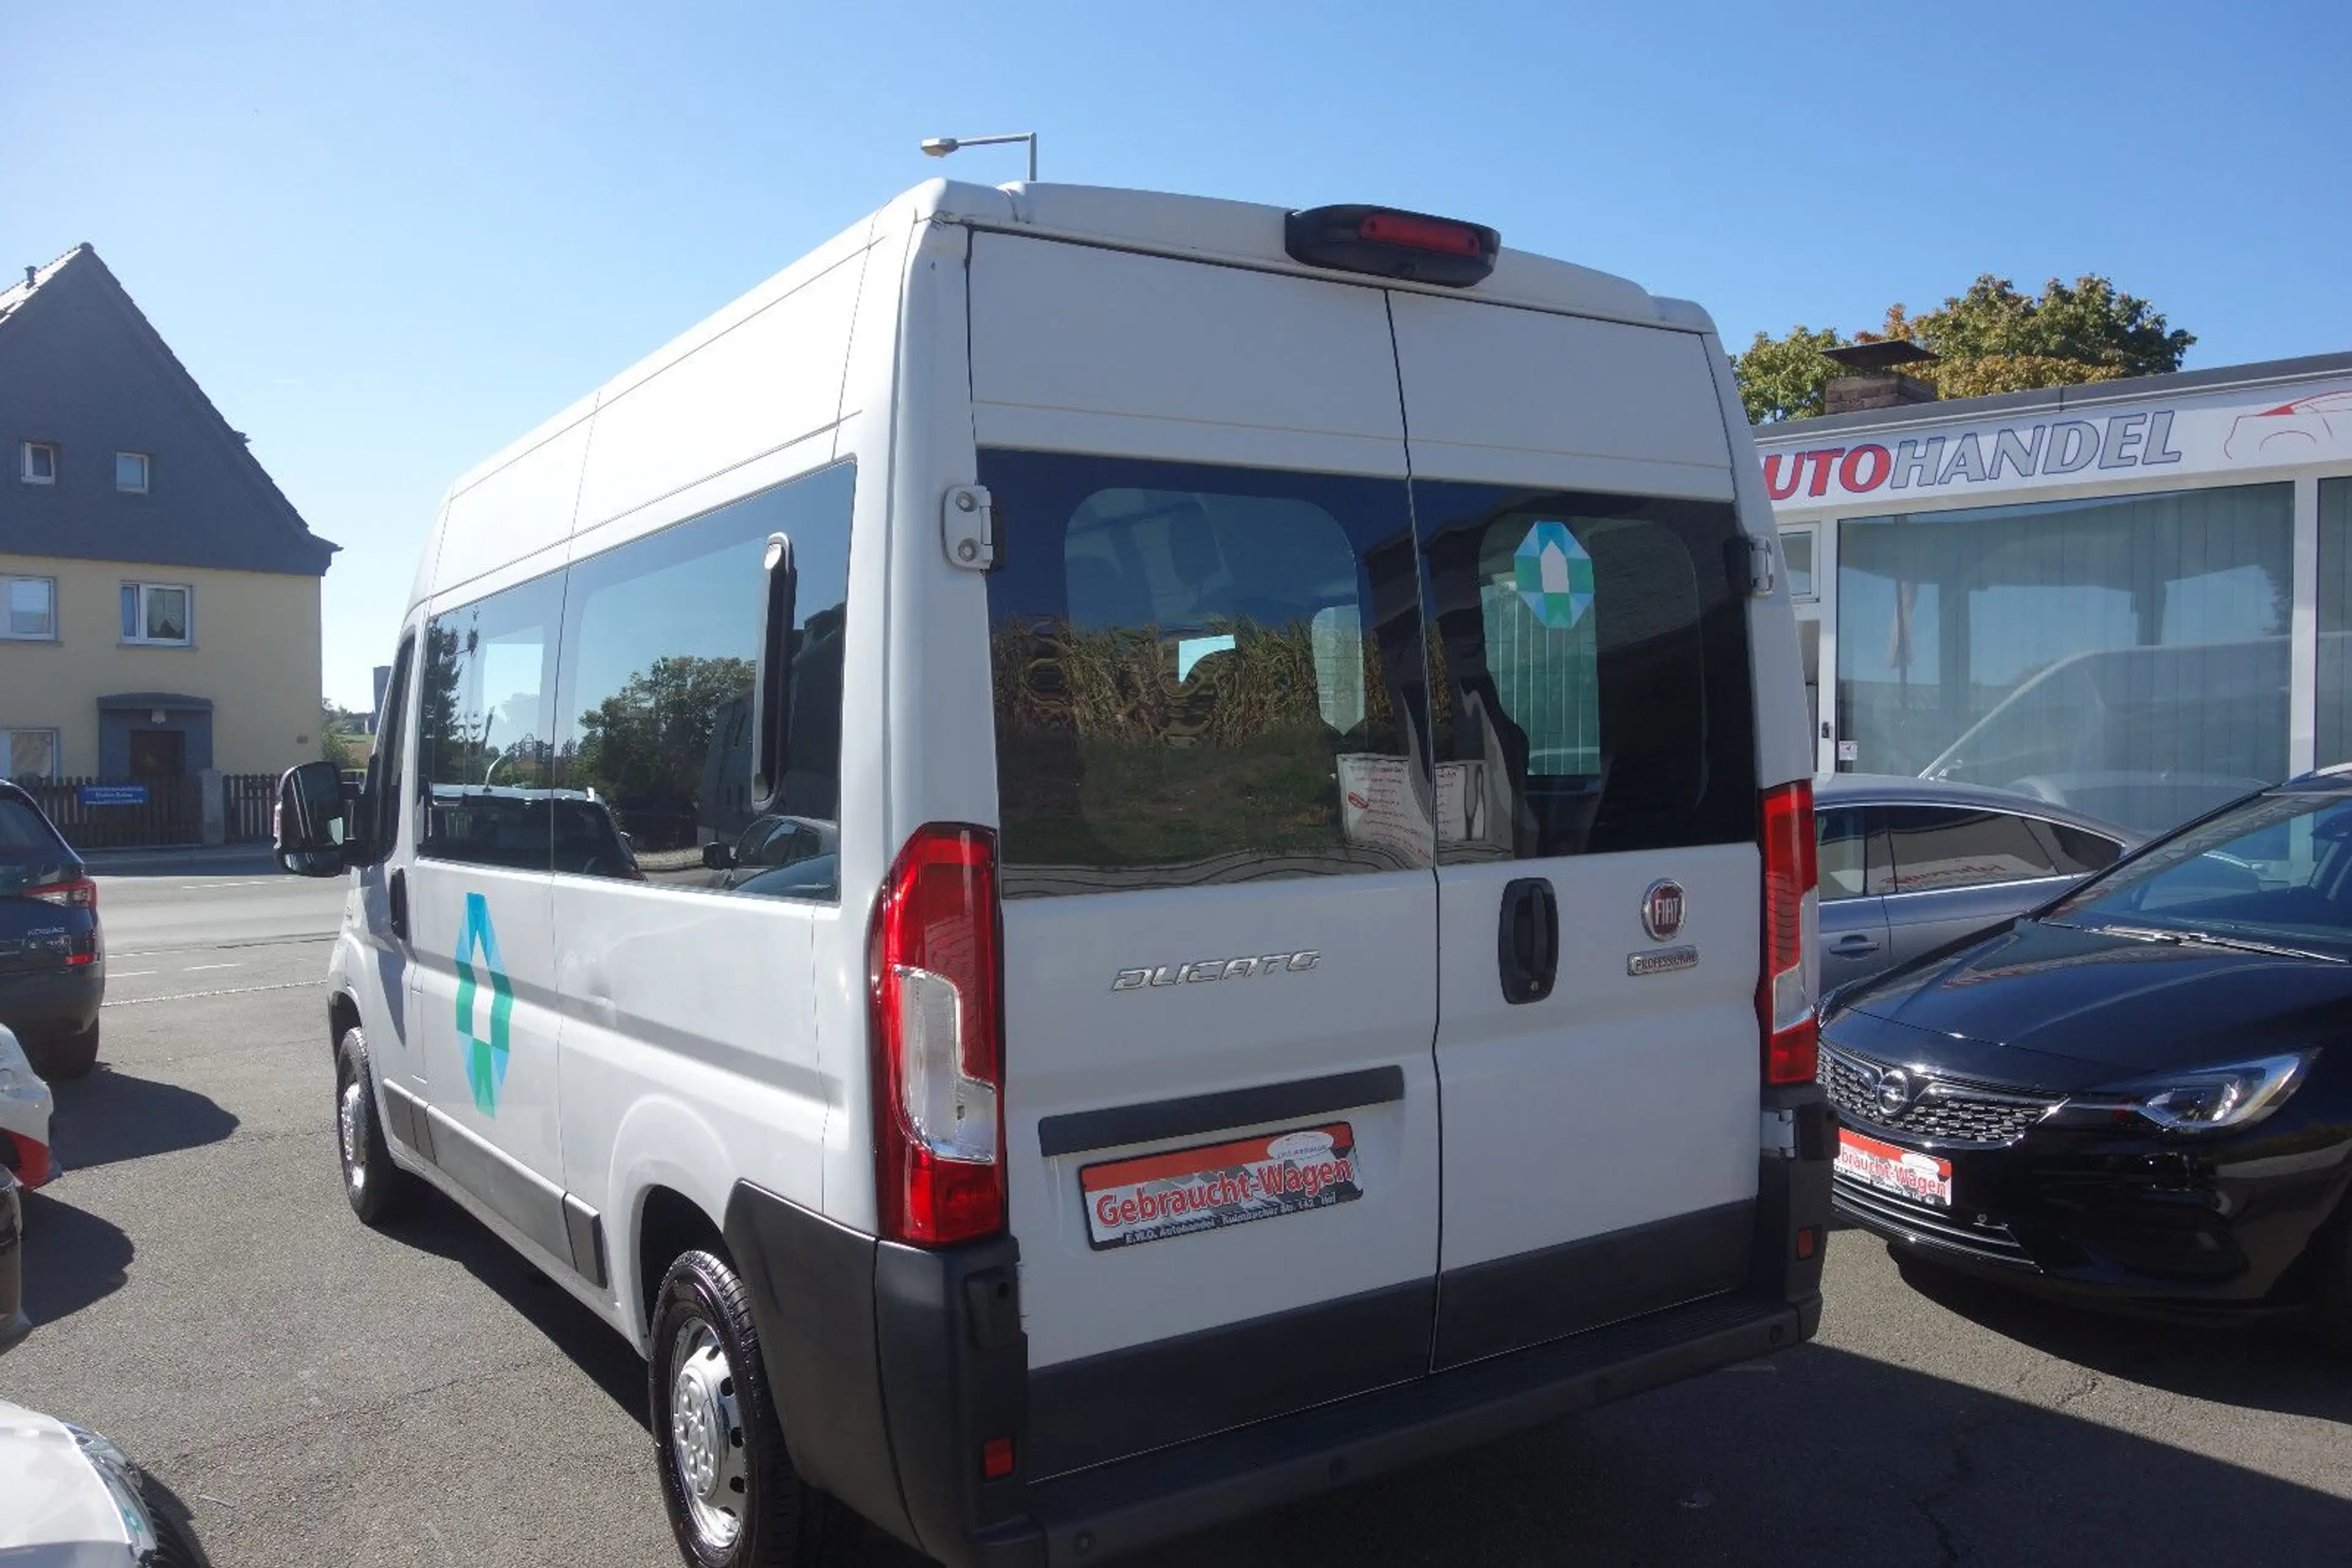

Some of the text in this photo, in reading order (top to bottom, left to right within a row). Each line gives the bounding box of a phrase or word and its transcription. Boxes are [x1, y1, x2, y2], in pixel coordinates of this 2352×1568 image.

[1655, 898, 1679, 926] FIAT
[1110, 949, 1321, 991] DUCATO
[1096, 1157, 1354, 1227] Gebraucht-Wagen
